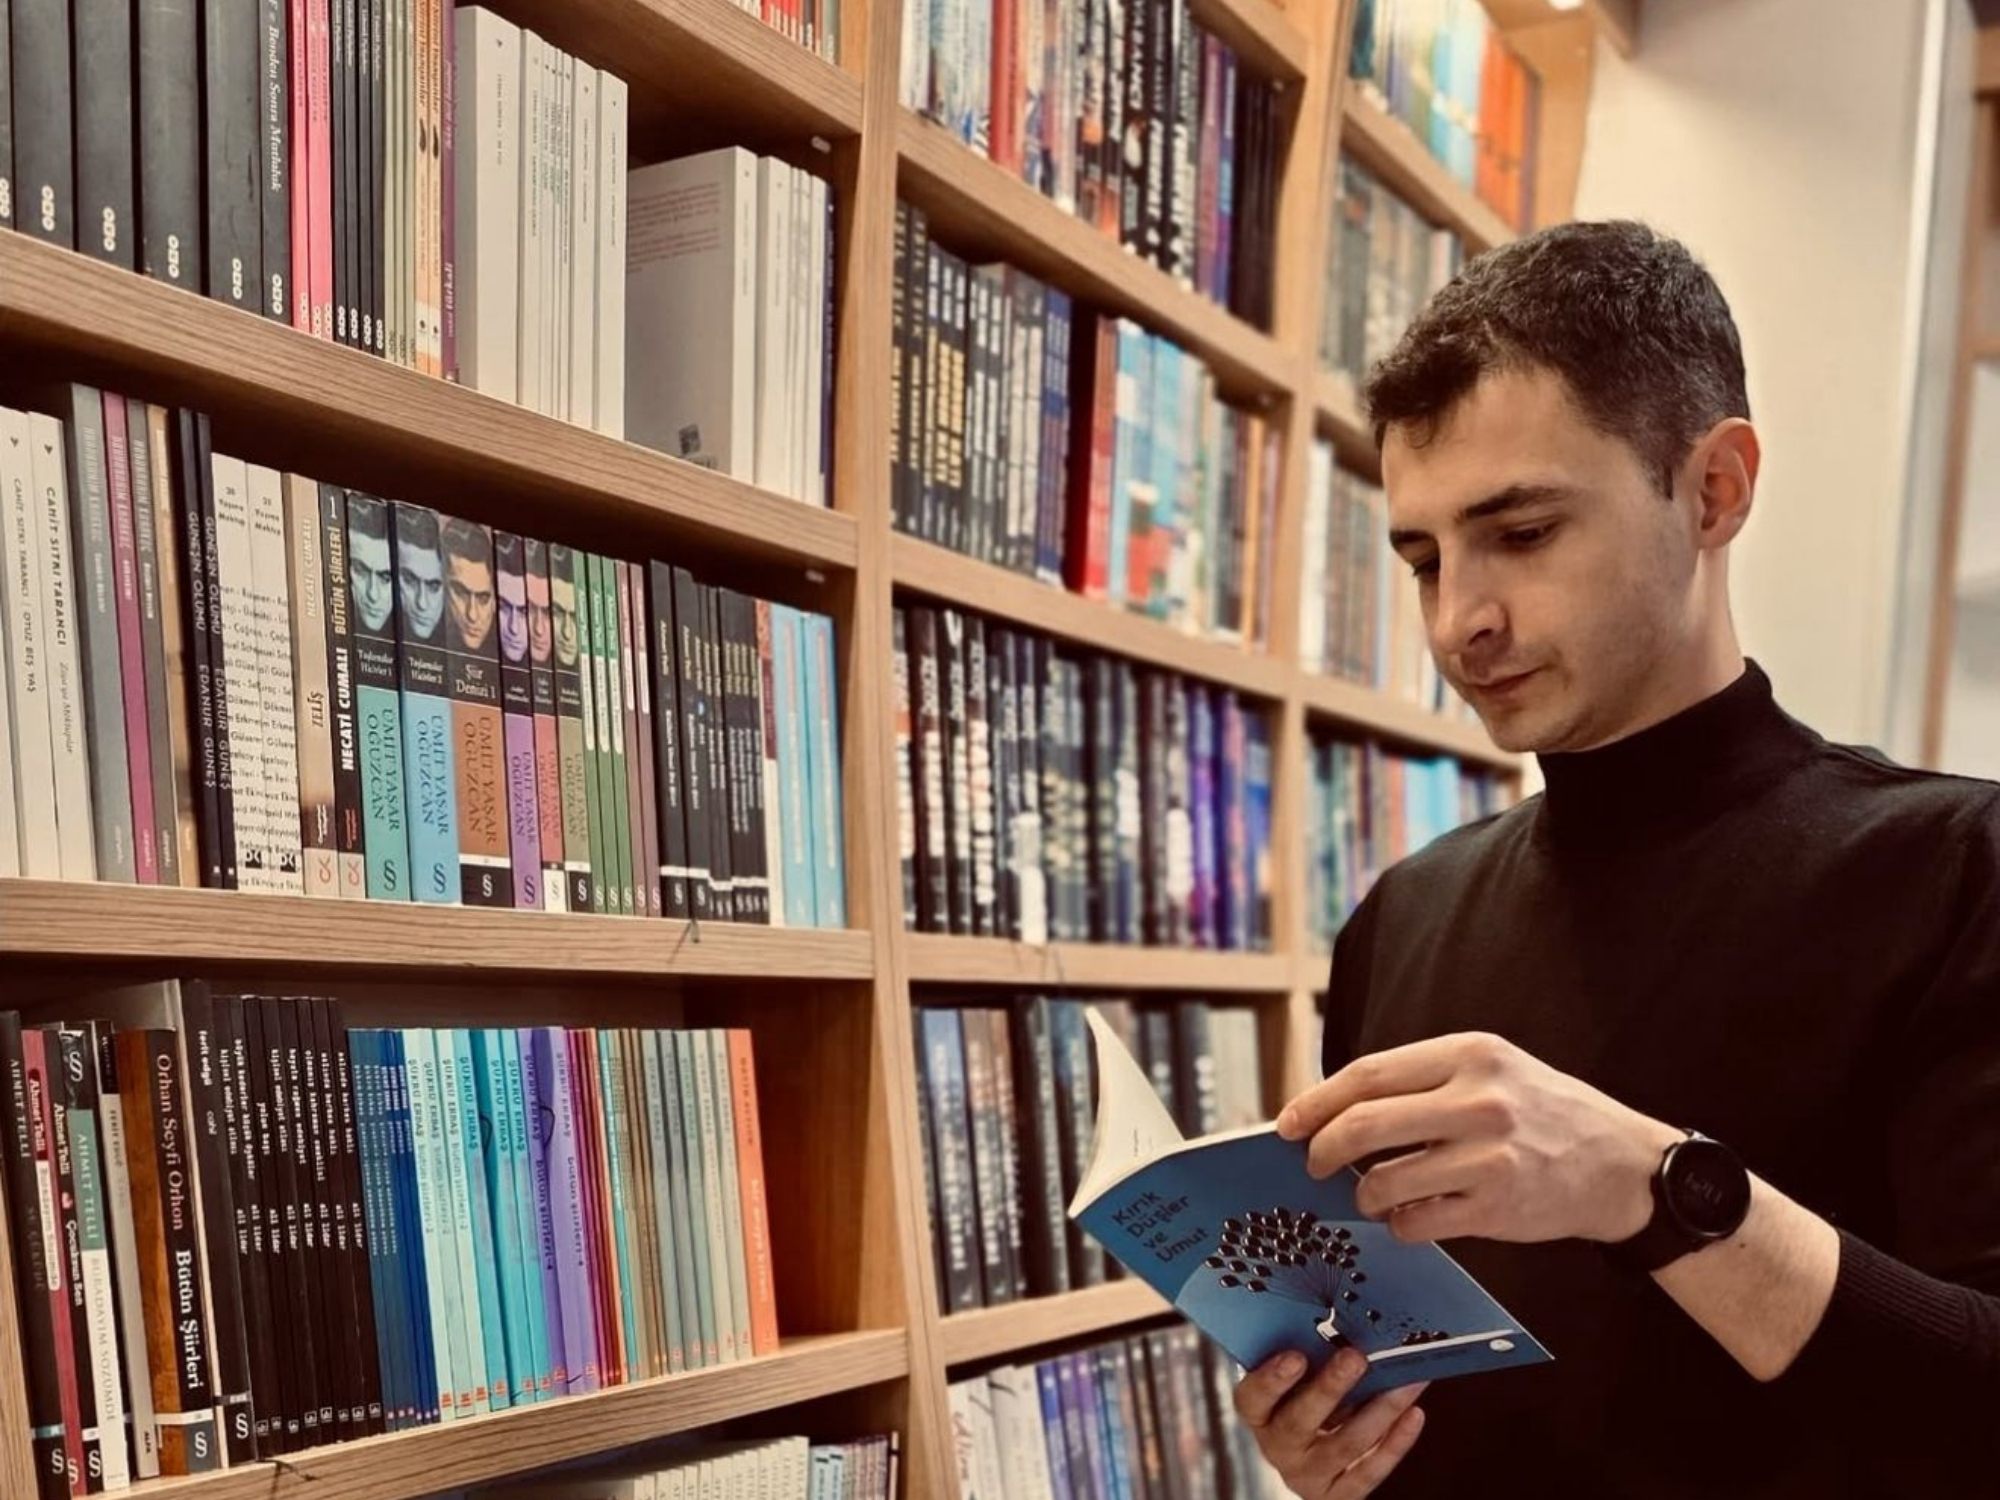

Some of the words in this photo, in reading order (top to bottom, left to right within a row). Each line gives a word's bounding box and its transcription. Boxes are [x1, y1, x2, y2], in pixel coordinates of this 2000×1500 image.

[268, 26, 280, 79] Benden
[268, 82, 281, 122] Sonra
[45, 486, 61, 533] CAHİT
[49, 537, 62, 577] SITKI
[22, 611, 34, 641] OTUZ
[51, 580, 68, 646] TARANCI
[330, 588, 346, 635] BÜTÜN
[660, 620, 668, 653] Ahmet
[683, 625, 691, 658] Ahmet
[26, 673, 36, 692] YAŞ
[195, 664, 214, 727] EDANUR
[335, 647, 350, 709] CUMALI
[456, 679, 488, 698] Denizi
[491, 686, 496, 698] 1
[211, 668, 229, 730] EDANUR
[307, 691, 325, 728] ZELİŞ
[337, 714, 354, 771] NECATİ
[199, 1030, 210, 1055] ferit
[233, 1039, 245, 1066] büyük
[199, 1056, 213, 1086] edgü
[218, 1049, 232, 1082] kişisel
[269, 1049, 282, 1081] kişisel
[287, 1048, 299, 1081] hayata
[321, 1052, 331, 1089] aslında
[338, 1052, 348, 1088] aslında
[10, 1058, 24, 1109] AHMET
[29, 1079, 43, 1122] Ahmet
[156, 1054, 176, 1113] Orhan
[237, 1069, 250, 1110] kederler
[291, 1085, 302, 1118] rağmen
[222, 1085, 236, 1123] edebiyat
[272, 1084, 286, 1121] edebiyat
[310, 1092, 321, 1135] kahraman
[325, 1093, 335, 1124] herkes
[341, 1091, 352, 1123] herkes
[34, 1122, 45, 1151] Telli
[53, 1103, 68, 1145] Ahmet
[158, 1117, 181, 1166] Seyfi
[241, 1113, 252, 1141] küçük
[328, 1129, 338, 1155] haklı
[345, 1128, 355, 1153] haklı
[58, 1147, 70, 1175] Telli
[243, 1143, 256, 1180] öyküler
[294, 1123, 307, 1165] edebiyat
[168, 1170, 186, 1231] Orhon
[1112, 1190, 1161, 1226] Kırık
[1127, 1196, 1190, 1238] Düşler
[65, 1220, 82, 1281] Çocuksun
[77, 1133, 93, 1189] AHMET
[91, 1258, 108, 1346] BURADAYIM
[1143, 1231, 1167, 1250] ve
[1156, 1228, 1210, 1263] Umut
[175, 1250, 196, 1313] Bütün
[179, 1319, 203, 1389] Şiirleri
